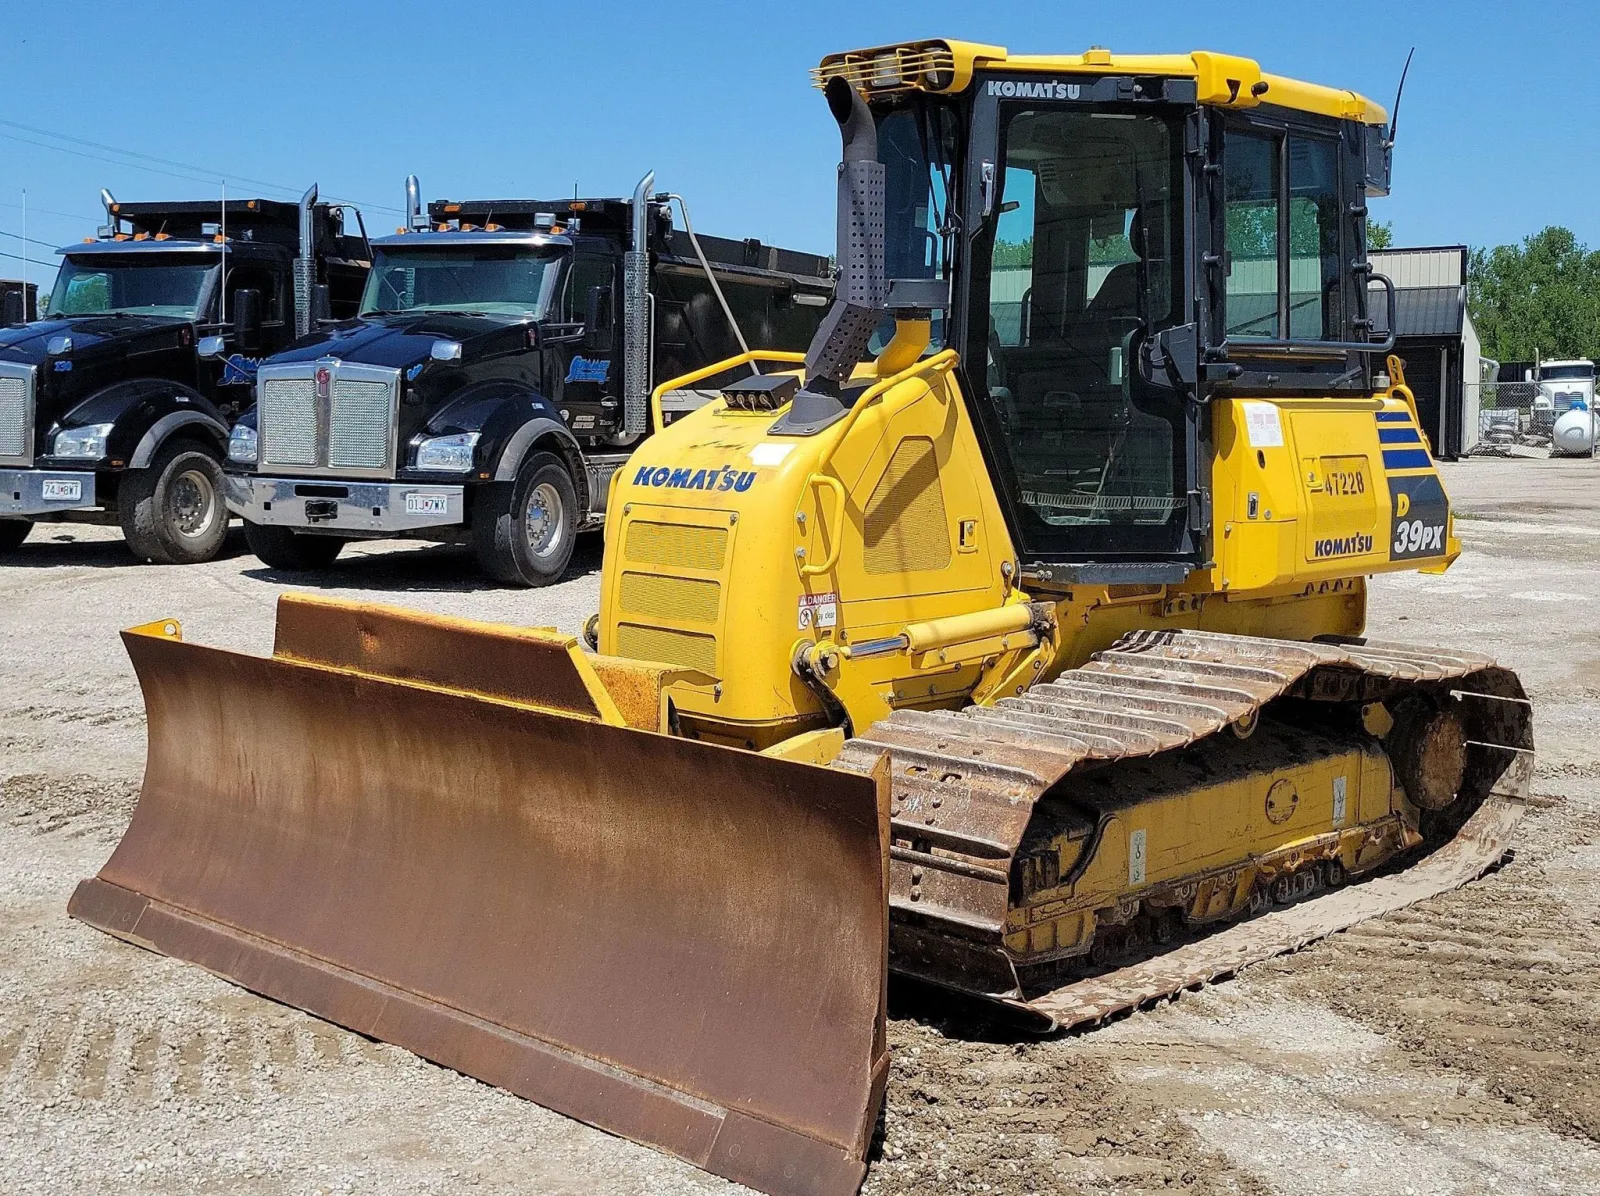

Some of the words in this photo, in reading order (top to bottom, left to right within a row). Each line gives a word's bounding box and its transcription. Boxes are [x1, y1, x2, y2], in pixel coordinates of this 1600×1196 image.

[987, 80, 1080, 99] KOMATSU
[632, 465, 757, 492] KOMATSU
[1396, 493, 1410, 517] D
[1314, 532, 1373, 557] KOMATSU
[1394, 519, 1444, 554] 39PX
[807, 594, 836, 605] DANGER
